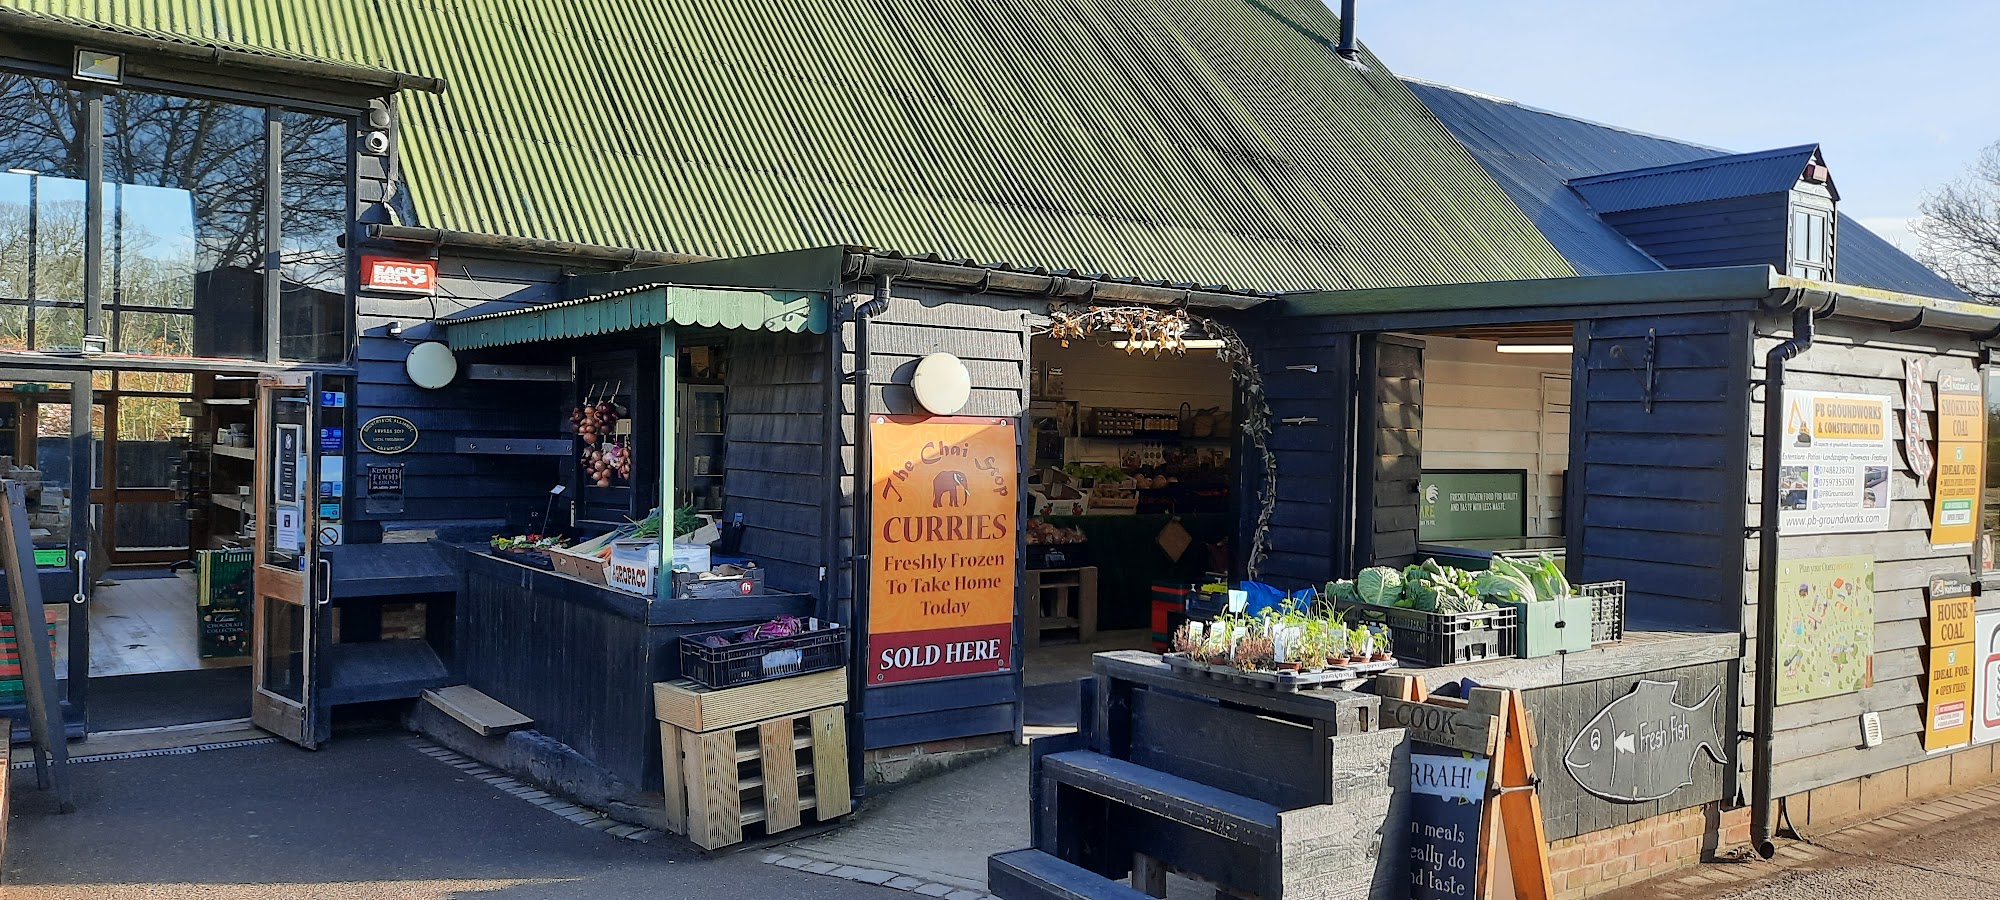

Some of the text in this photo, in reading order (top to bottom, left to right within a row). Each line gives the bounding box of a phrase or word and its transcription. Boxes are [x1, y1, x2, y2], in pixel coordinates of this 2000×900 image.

[373, 265, 426, 276] EAGLE
[1815, 403, 1882, 420] PB GROUNDWORKS
[1909, 367, 1918, 462] BARBERS
[1941, 400, 1980, 416] SMOKELESS
[1818, 422, 1880, 435] & CONSTRUCTION LTD
[1953, 420, 1969, 437] COAL
[373, 473, 399, 481] FOOD
[882, 460, 915, 503] The
[920, 440, 969, 465] Chai
[1941, 464, 1960, 475] IDEAL
[1449, 492, 1518, 502] FRESHLY FROZEN FOOD FOR QUALITY
[1450, 503, 1460, 512] AND
[1460, 503, 1473, 511] TASTE
[1483, 503, 1492, 511] LESS
[1492, 503, 1506, 511] WASTE
[882, 513, 1008, 544] CURRIES
[1785, 512, 1880, 528] www.pb-groundworks.com
[884, 553, 1005, 573] Freshly Frozen
[1799, 564, 1810, 574] Plan
[1811, 565, 1821, 575] your
[886, 575, 1002, 595] To Take Home
[1944, 584, 1962, 594] National
[920, 598, 970, 617] Today
[1937, 602, 1968, 621] HOUSE
[1941, 622, 1965, 641] COAL
[880, 638, 1001, 670] SOLD HERE
[1933, 665, 1970, 681] IDEAL FOR:
[1940, 682, 1967, 696] OPEN FIRES
[1395, 704, 1457, 735] COOK
[1639, 713, 1690, 752] Fresh Fish
[1424, 823, 1465, 844] meals
[1448, 849, 1465, 870] do
[1428, 870, 1466, 896] taste
